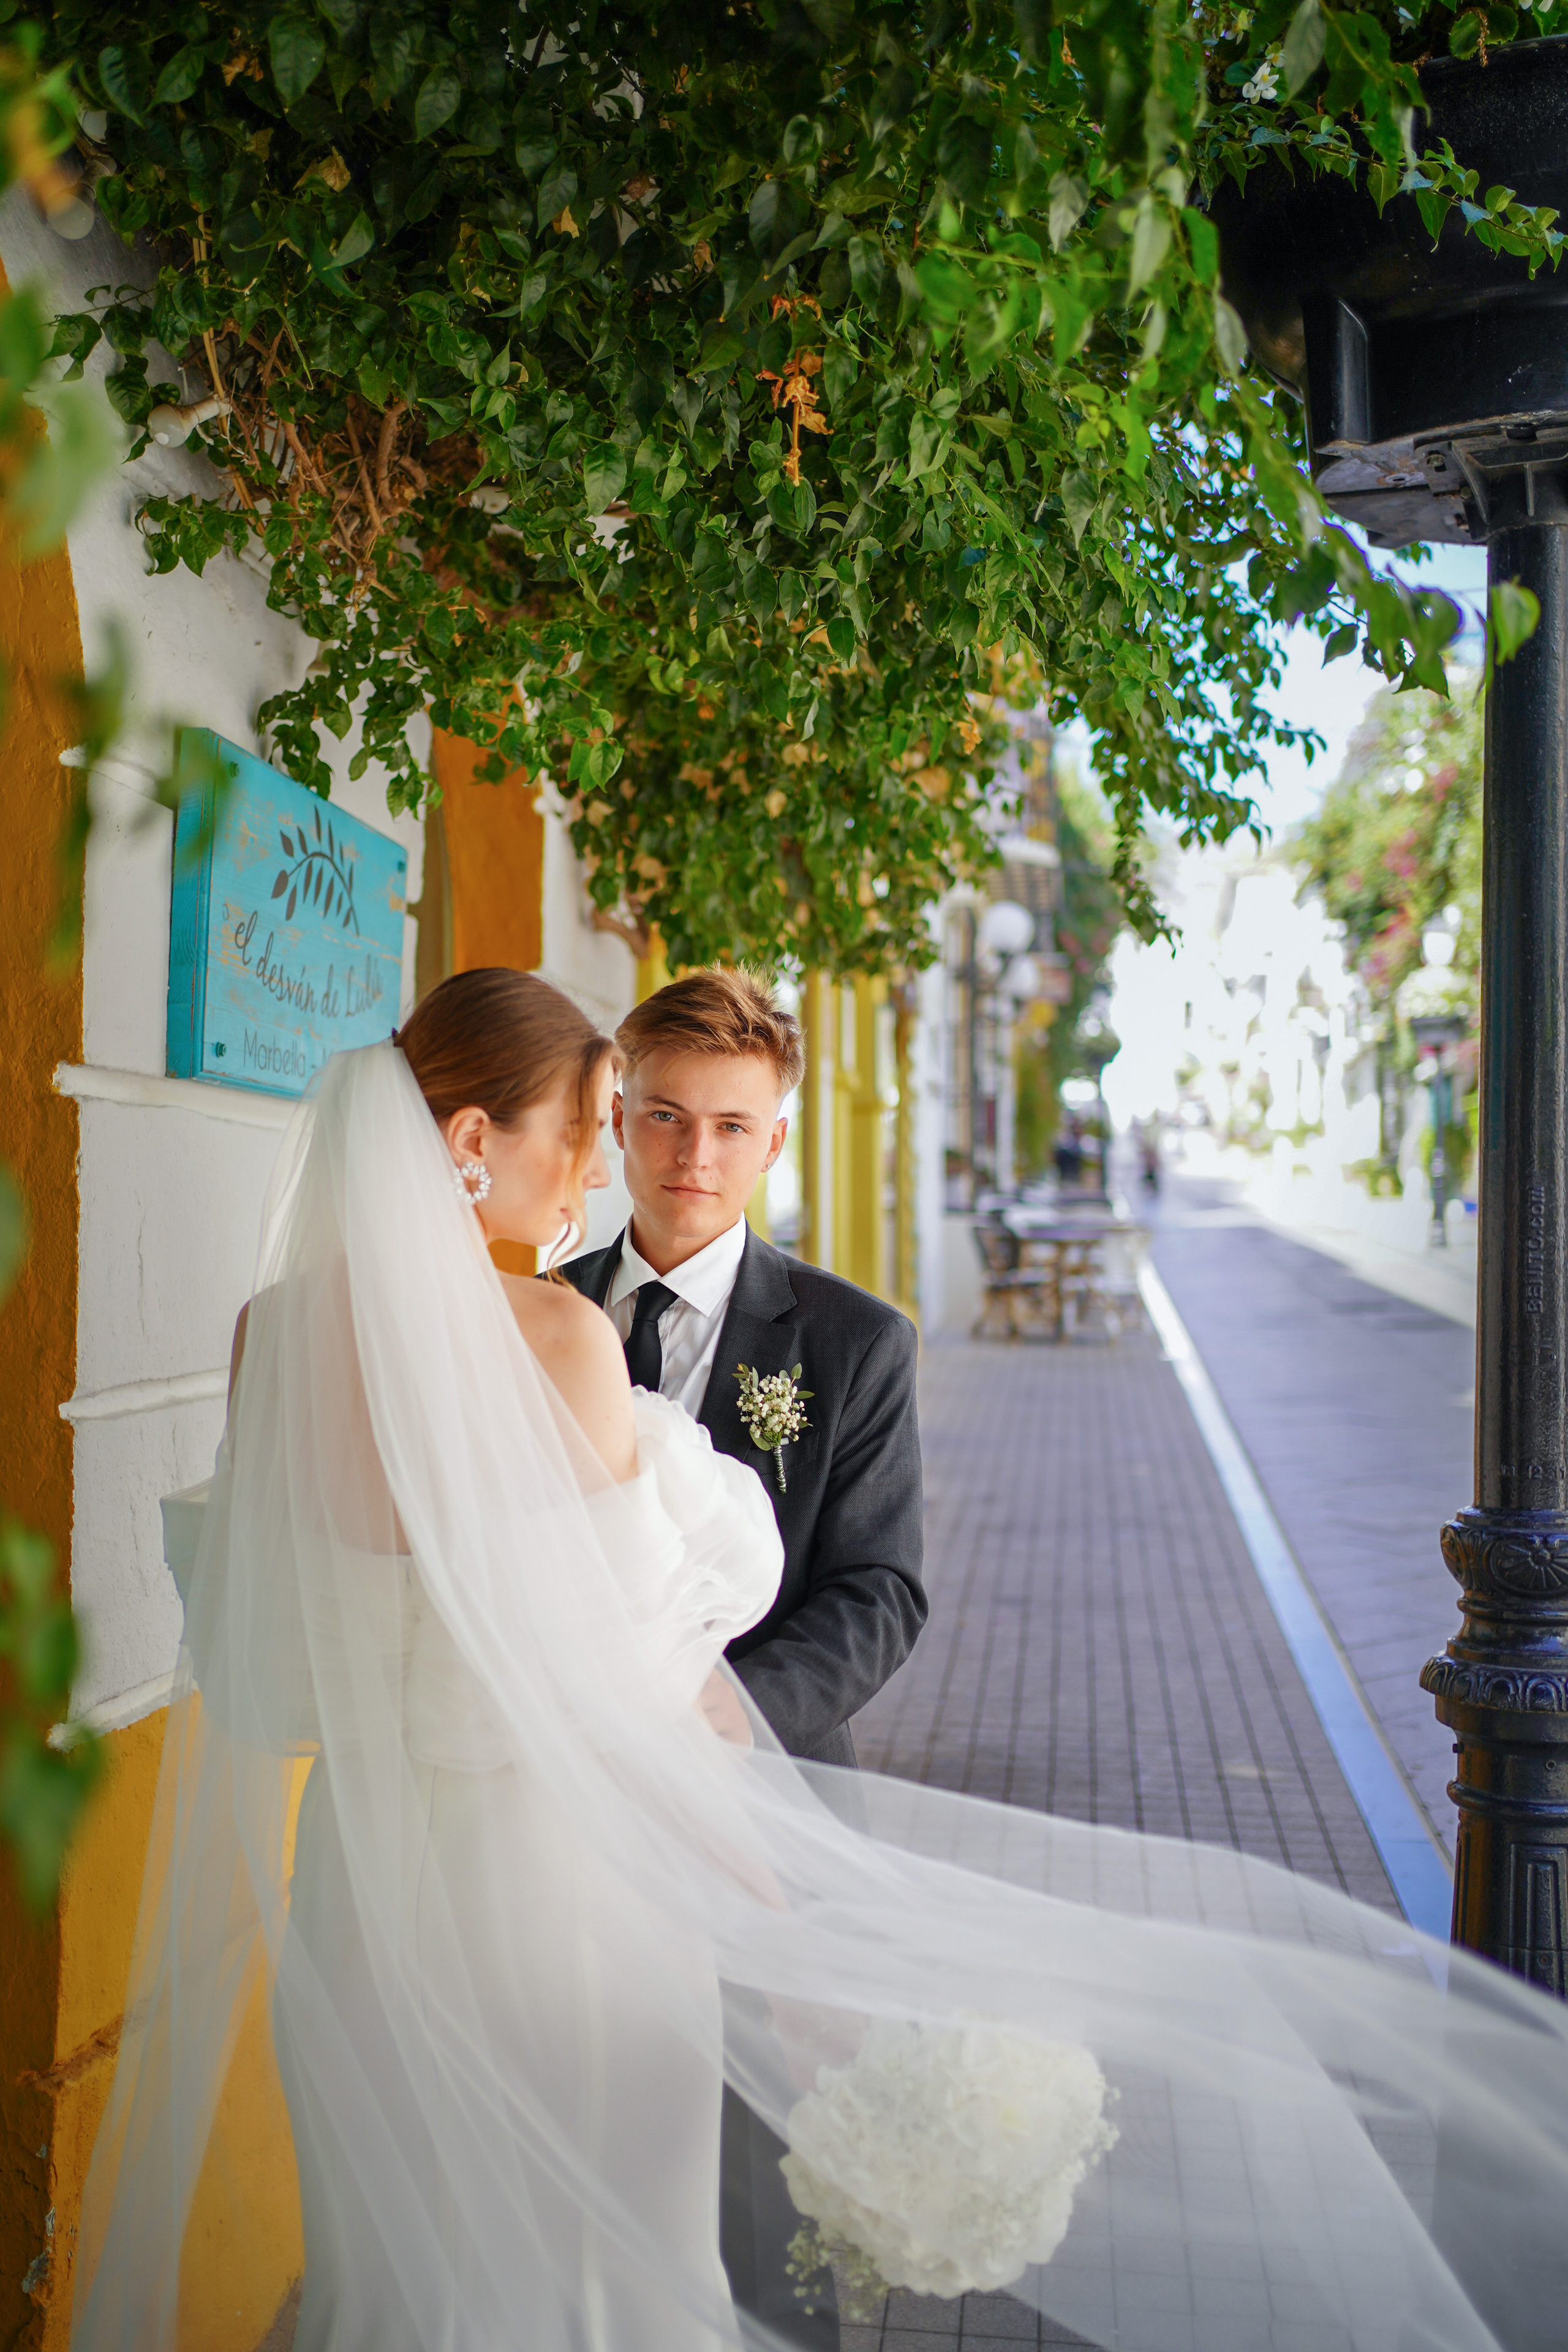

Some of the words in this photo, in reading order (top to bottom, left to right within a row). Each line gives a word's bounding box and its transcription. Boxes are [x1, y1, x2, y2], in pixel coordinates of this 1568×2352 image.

[235, 910, 258, 966] el
[256, 932, 317, 1014] desván
[321, 964, 341, 1017] de
[244, 1028, 306, 1078] Marbella
[1525, 1184, 1545, 1313] BENITO.com
